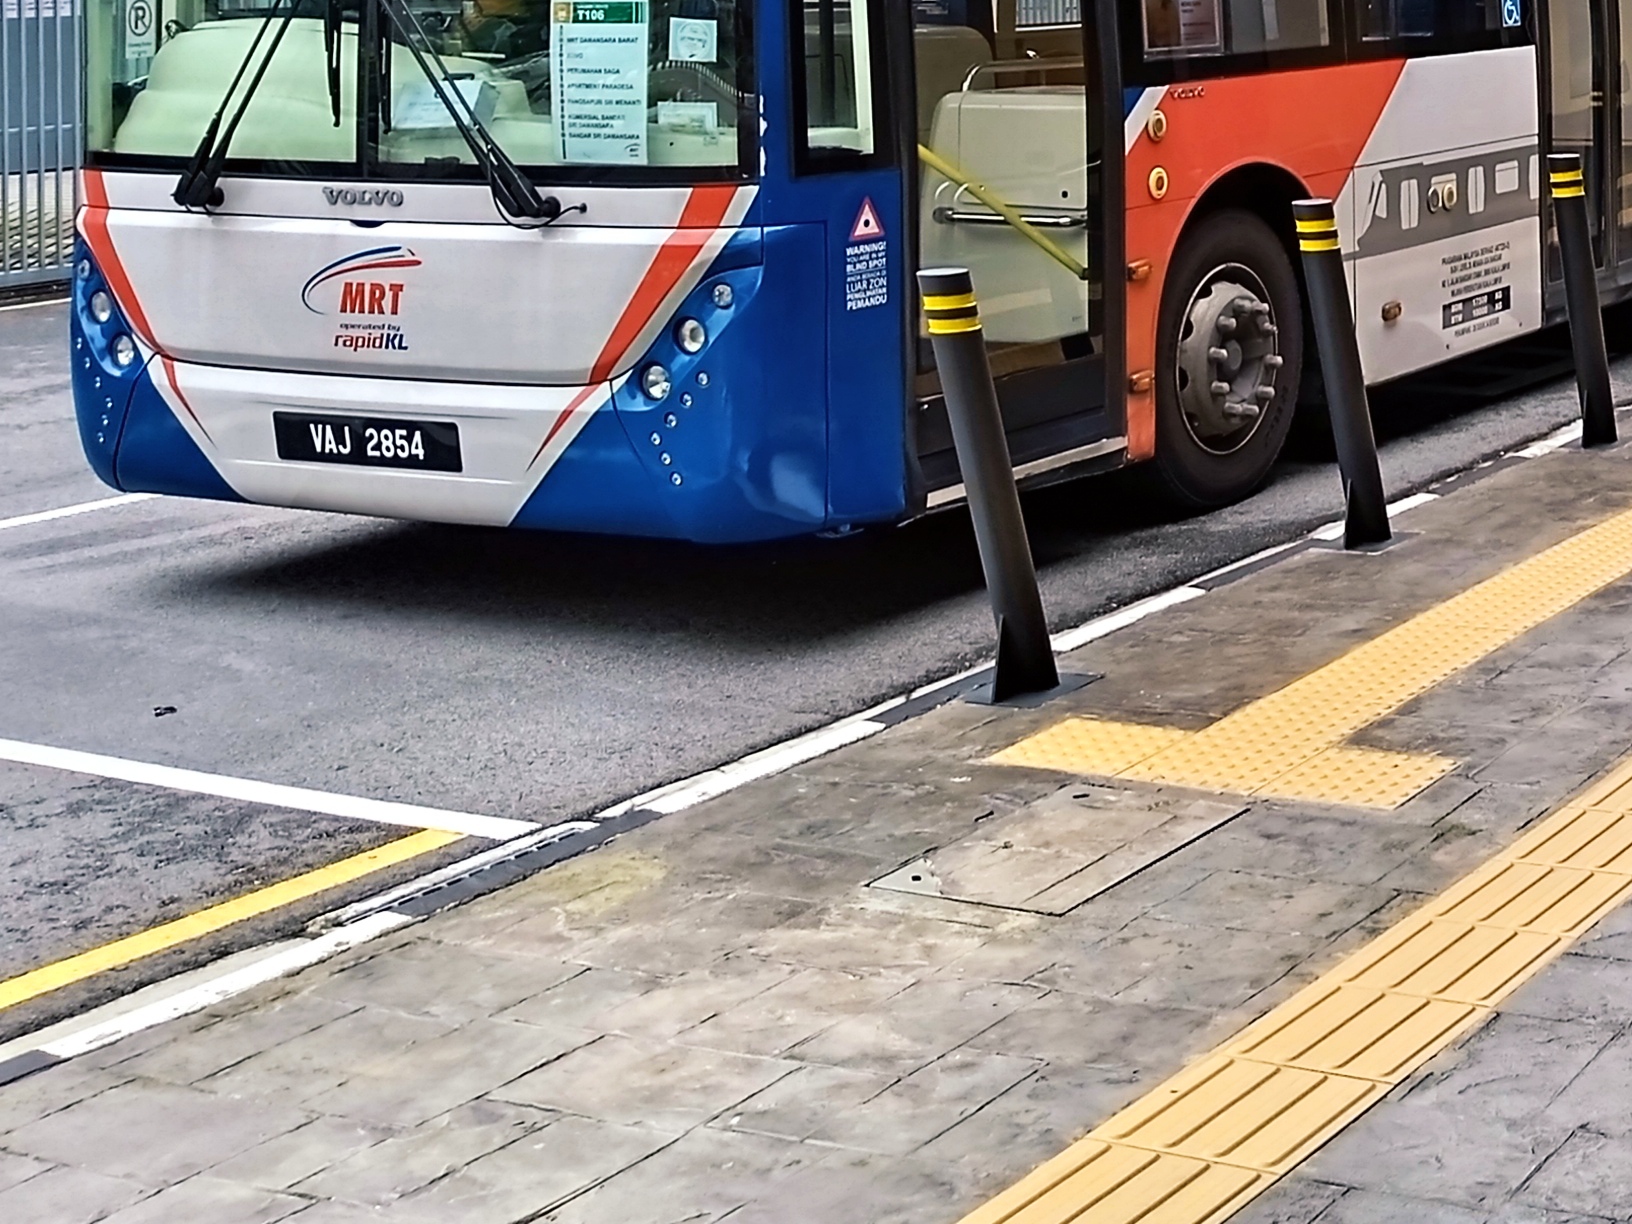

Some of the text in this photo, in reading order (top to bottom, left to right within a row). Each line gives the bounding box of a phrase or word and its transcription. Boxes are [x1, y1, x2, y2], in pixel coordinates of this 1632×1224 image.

[577, 9, 605, 21] T106
[322, 186, 404, 207] VOLVO
[846, 240, 887, 257] WARNING!
[846, 257, 887, 273] BLIND SPOT
[846, 276, 888, 294] LUAR ZON
[339, 282, 405, 315] MRT
[847, 293, 888, 311] PEMANDU
[340, 323, 401, 333] operated by
[334, 332, 409, 352] rapidKL
[309, 423, 425, 460] VAJ 2854
